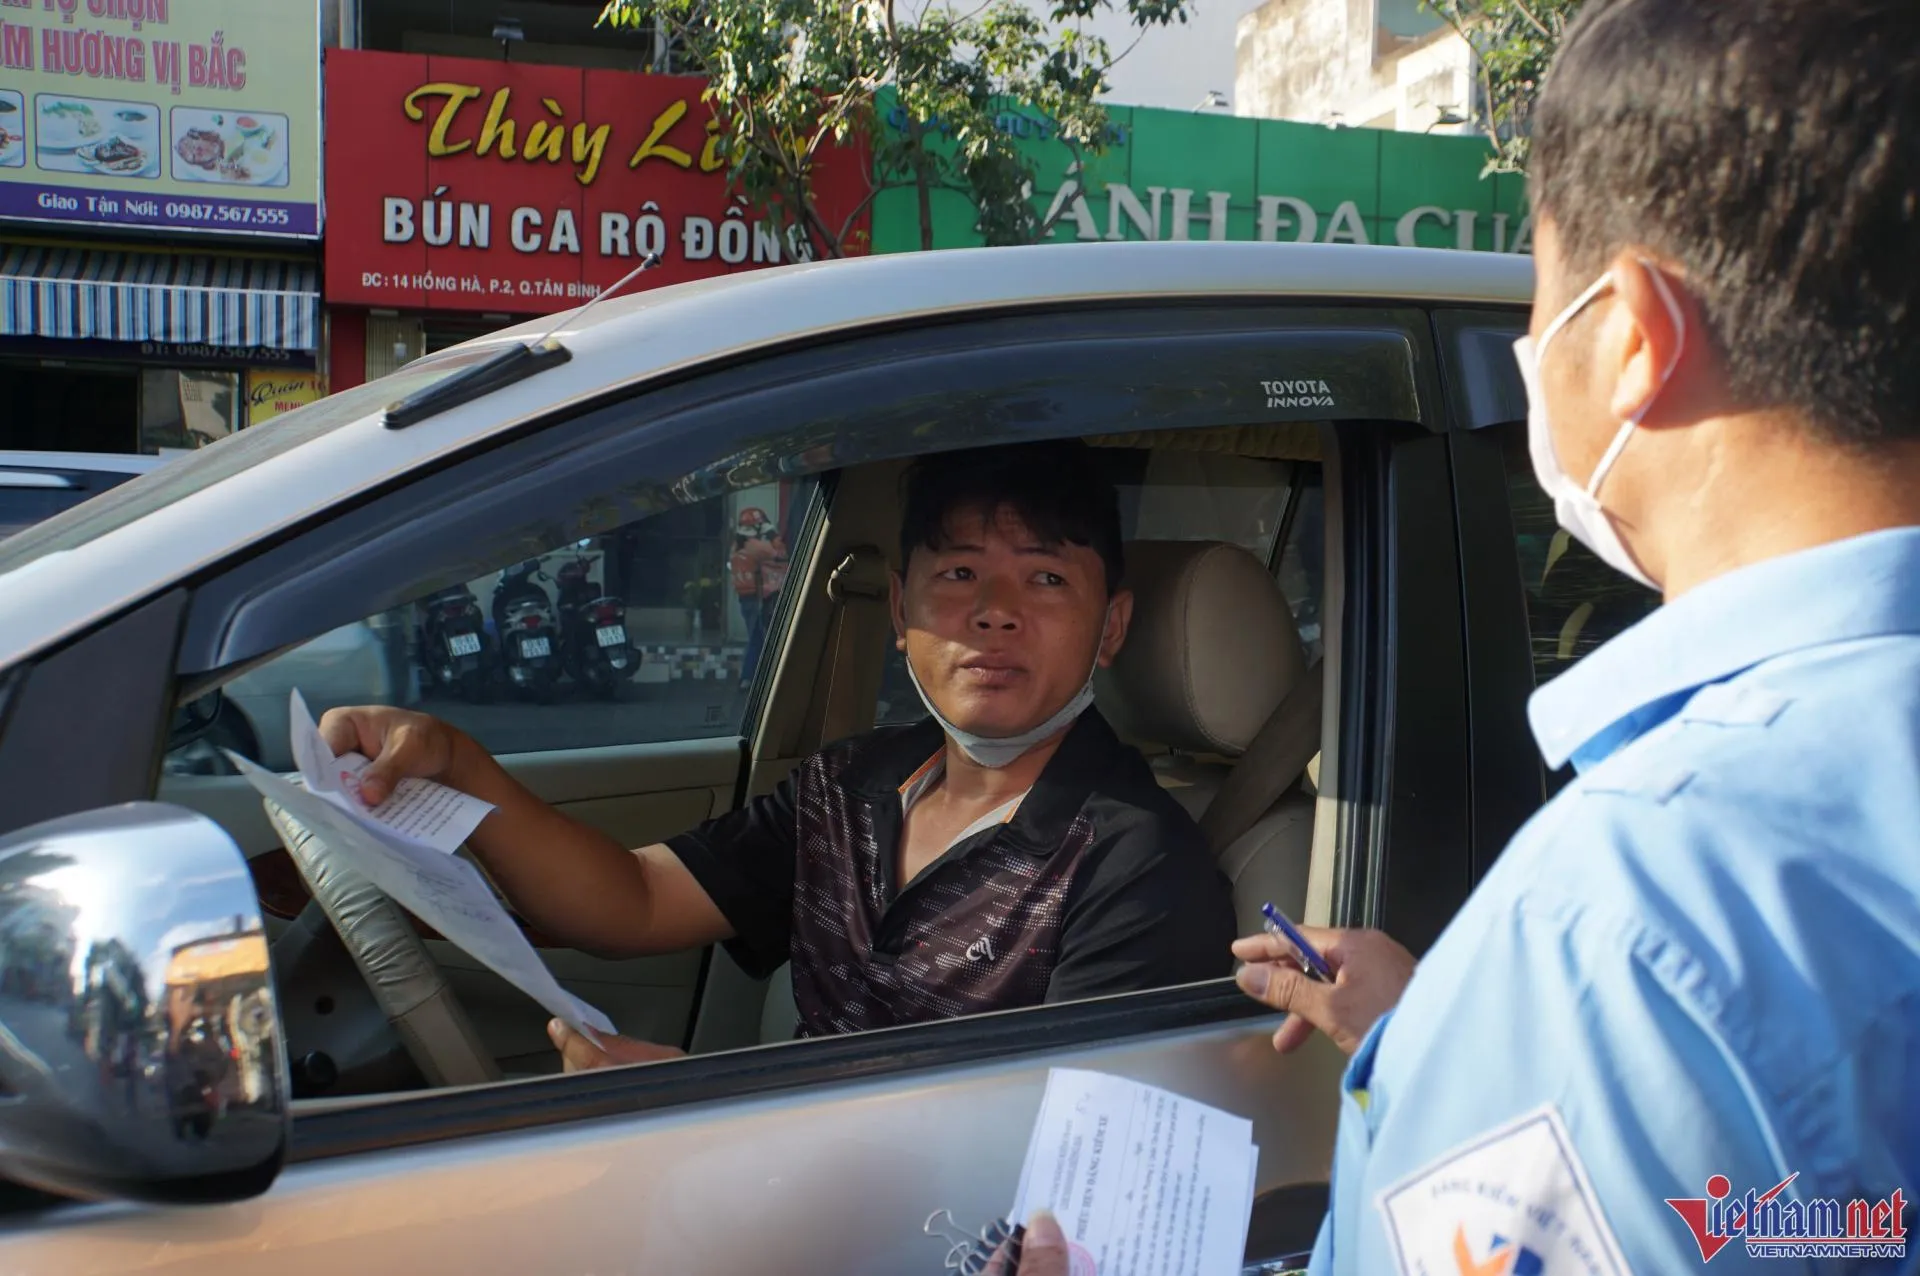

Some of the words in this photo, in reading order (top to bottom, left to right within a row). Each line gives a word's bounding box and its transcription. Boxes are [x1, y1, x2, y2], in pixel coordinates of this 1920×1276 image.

[0, 18, 34, 70] M
[42, 27, 146, 82] HƯƠNG
[152, 40, 181, 95] VỊ
[188, 30, 246, 90] BẮC
[404, 82, 611, 185] Thùy
[38, 192, 78, 210] Giao
[86, 195, 119, 217] Tận
[165, 202, 289, 225] 0987.567.555
[383, 186, 490, 248] BÚN
[600, 201, 666, 258] RÔ
[681, 195, 813, 263] ĐỒNG
[1044, 160, 1231, 243] ÁNH
[1256, 195, 1371, 246] ĐA
[392, 275, 409, 289] 14
[460, 275, 485, 294] HÀ,
[489, 279, 516, 296] P.2,
[519, 278, 563, 298] Q.TÂN
[567, 280, 601, 299] BÌNH
[1260, 380, 1331, 395] TOYOTA
[1266, 395, 1336, 408] INNOVA
